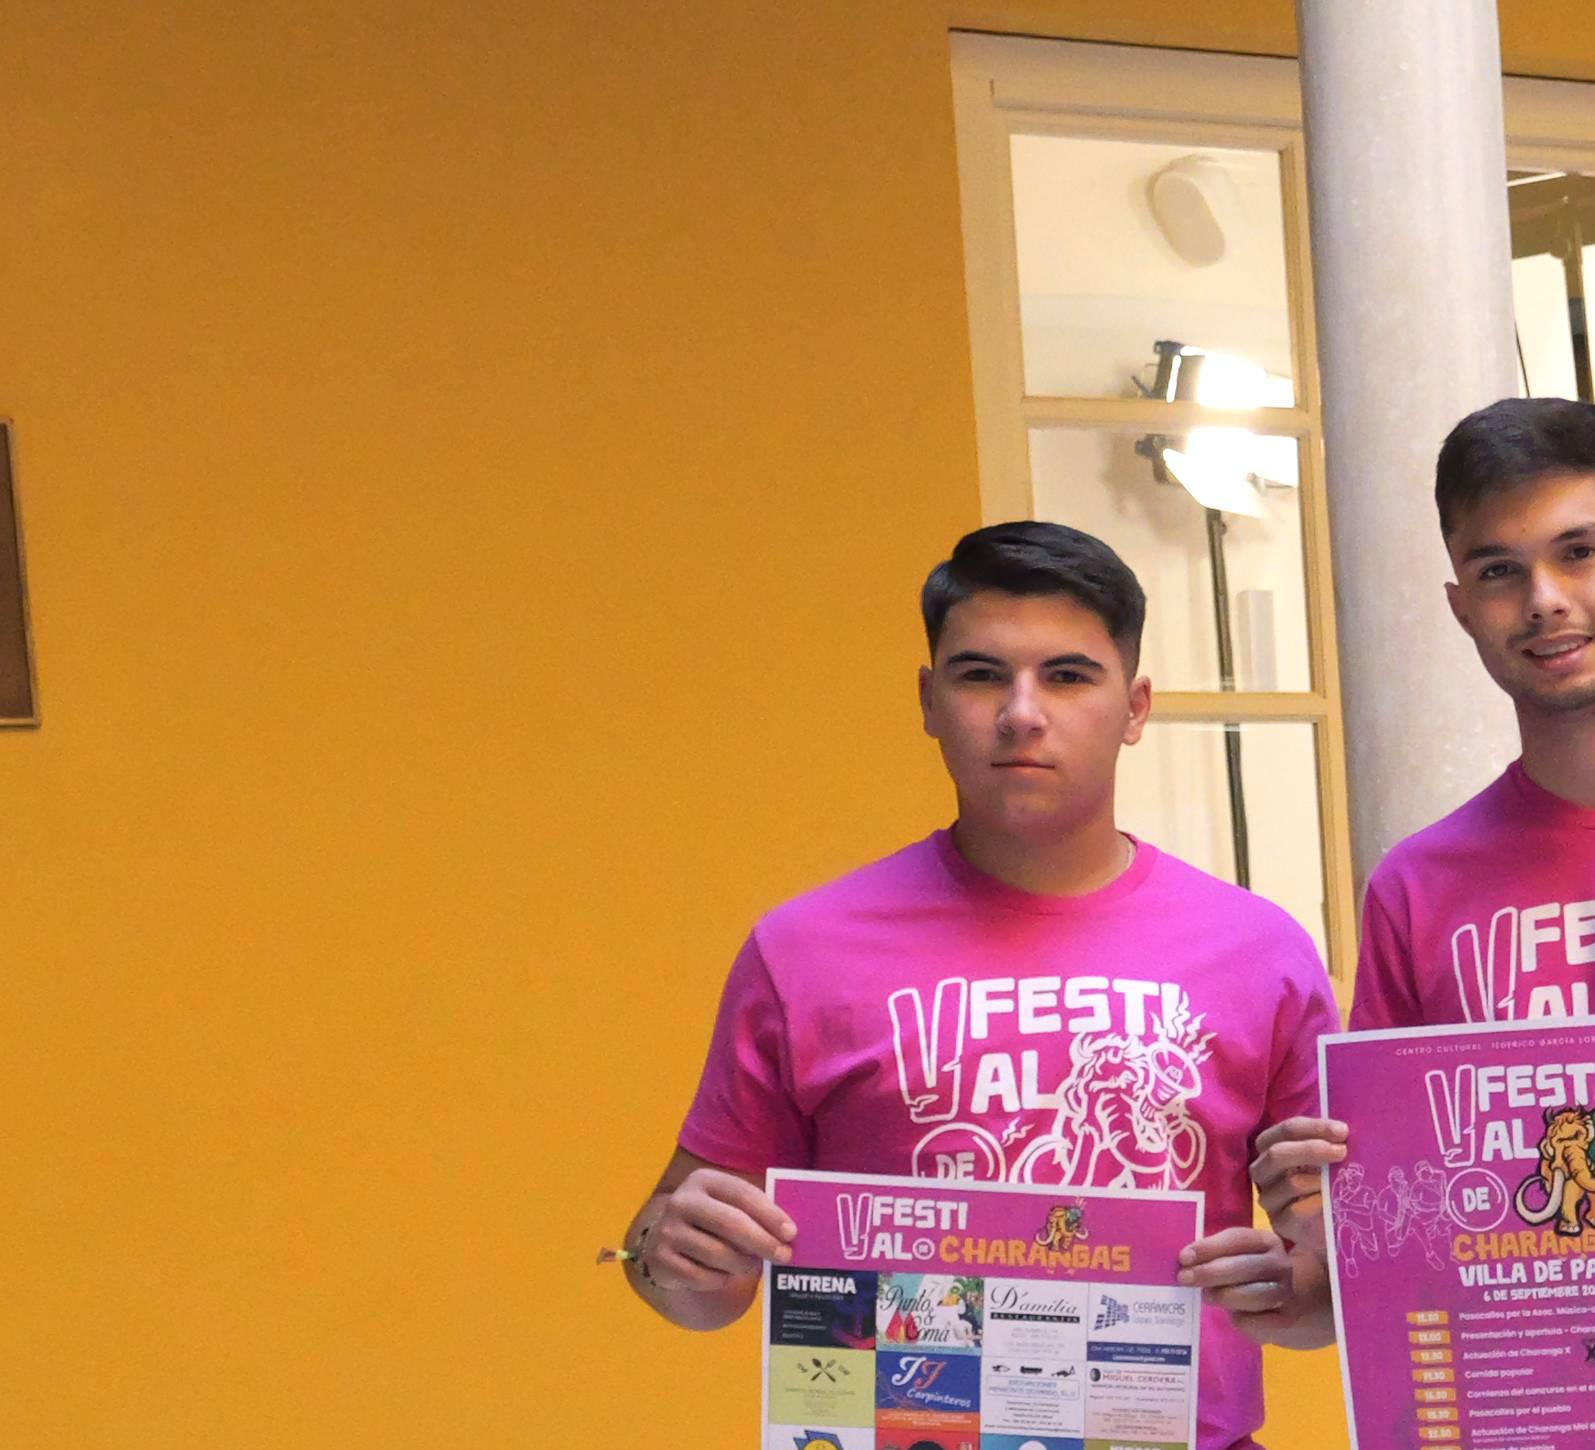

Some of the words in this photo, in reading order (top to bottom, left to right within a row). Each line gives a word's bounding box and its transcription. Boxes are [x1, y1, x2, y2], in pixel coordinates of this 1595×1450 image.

[970, 975, 1181, 1040] FESTI
[970, 1049, 1060, 1115] AL
[1425, 1064, 1476, 1168] V
[1481, 1118, 1541, 1162] AL
[872, 1196, 968, 1230] FESTI
[1461, 1186, 1491, 1213] DE
[870, 1232, 913, 1260] AL
[939, 1235, 1132, 1272] CHARANGAS
[776, 1273, 857, 1294] ENTRENA
[1458, 1262, 1527, 1287] VILLA
[1533, 1259, 1563, 1283] DE
[1483, 1290, 1491, 1303] 6
[1493, 1289, 1508, 1302] DE
[1510, 1285, 1579, 1301] SEPTIEMBRE
[906, 1388, 972, 1408] Carpinteros
